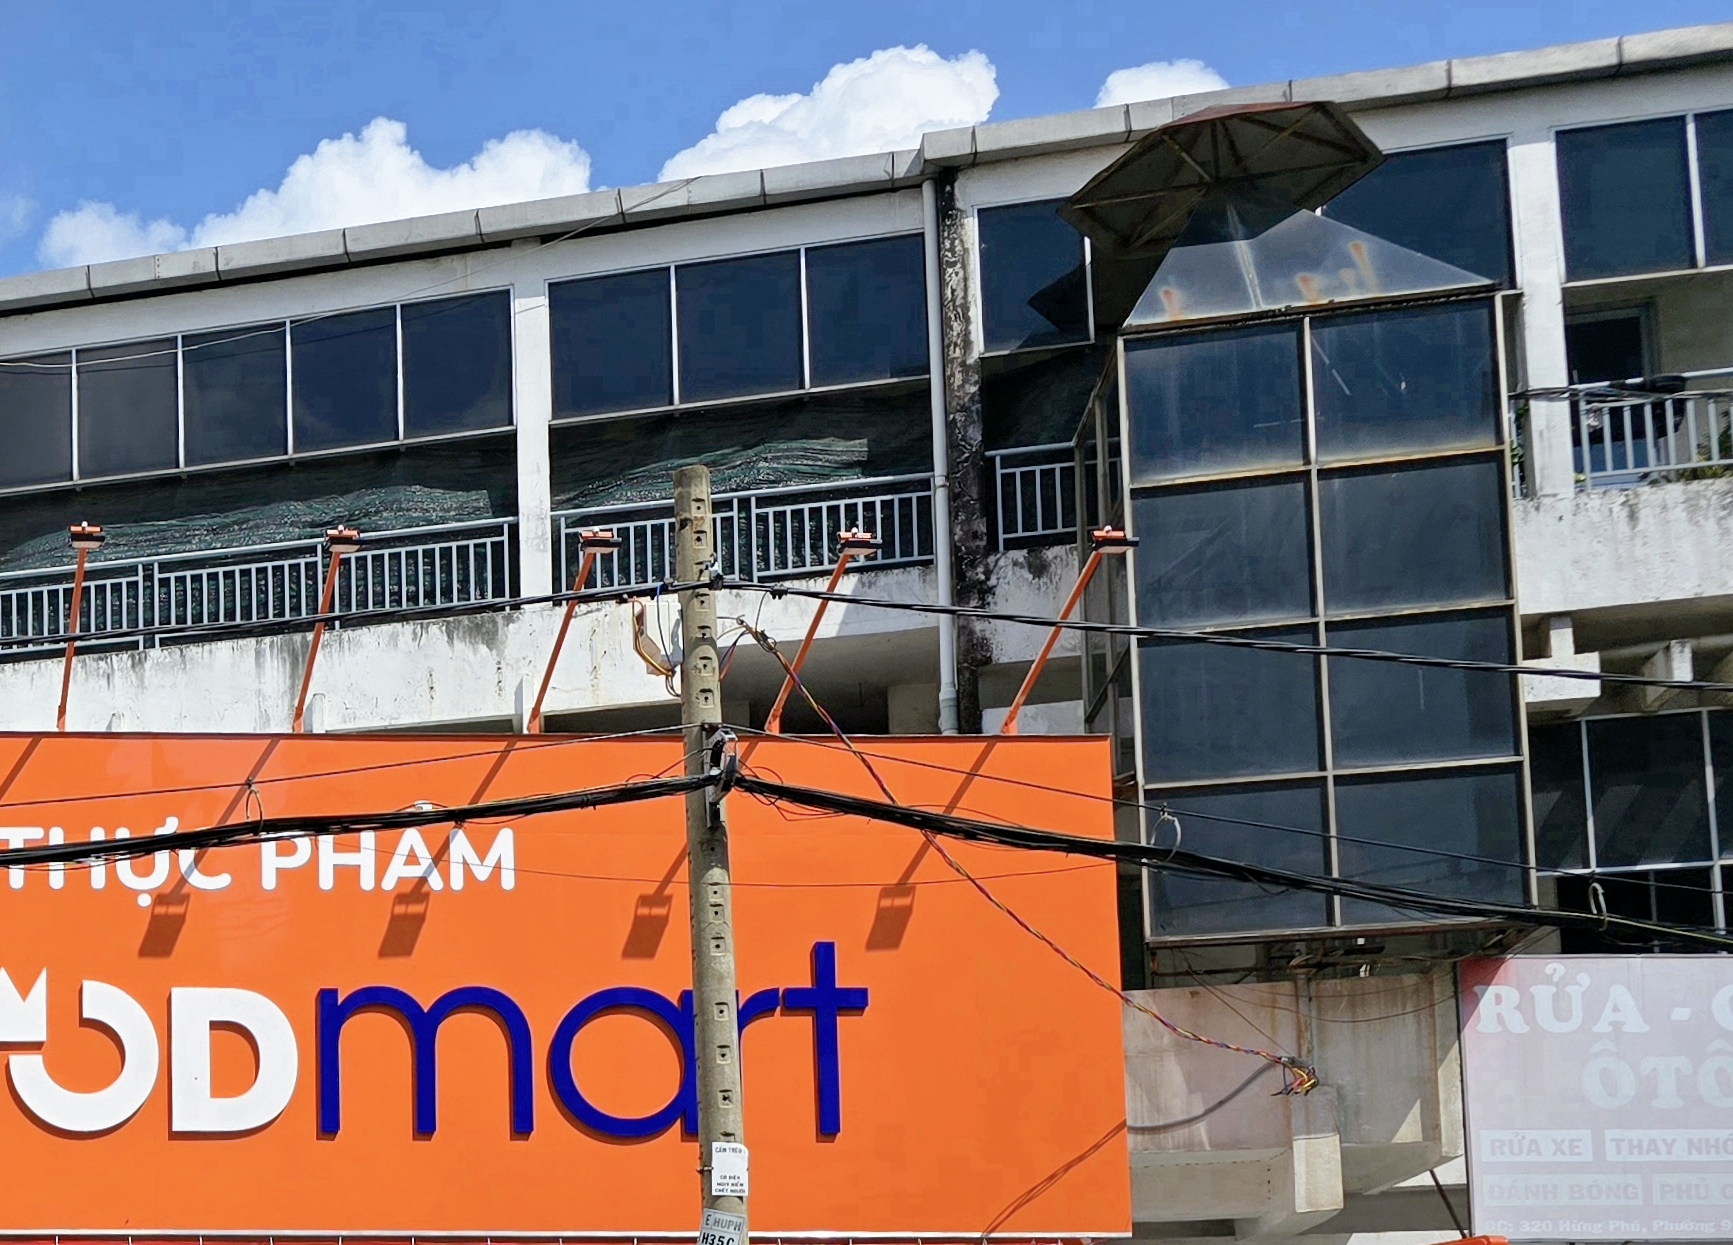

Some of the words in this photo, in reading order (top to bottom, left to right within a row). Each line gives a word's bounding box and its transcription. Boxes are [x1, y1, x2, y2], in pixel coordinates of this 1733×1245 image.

[1474, 962, 1651, 1034] RỬA
[1580, 1038, 1733, 1110] ÔTÔ
[1489, 1132, 1543, 1156] RỬA
[1550, 1138, 1583, 1156] XE
[1610, 1138, 1677, 1155] THAY
[1519, 1219, 1553, 1232] 320
